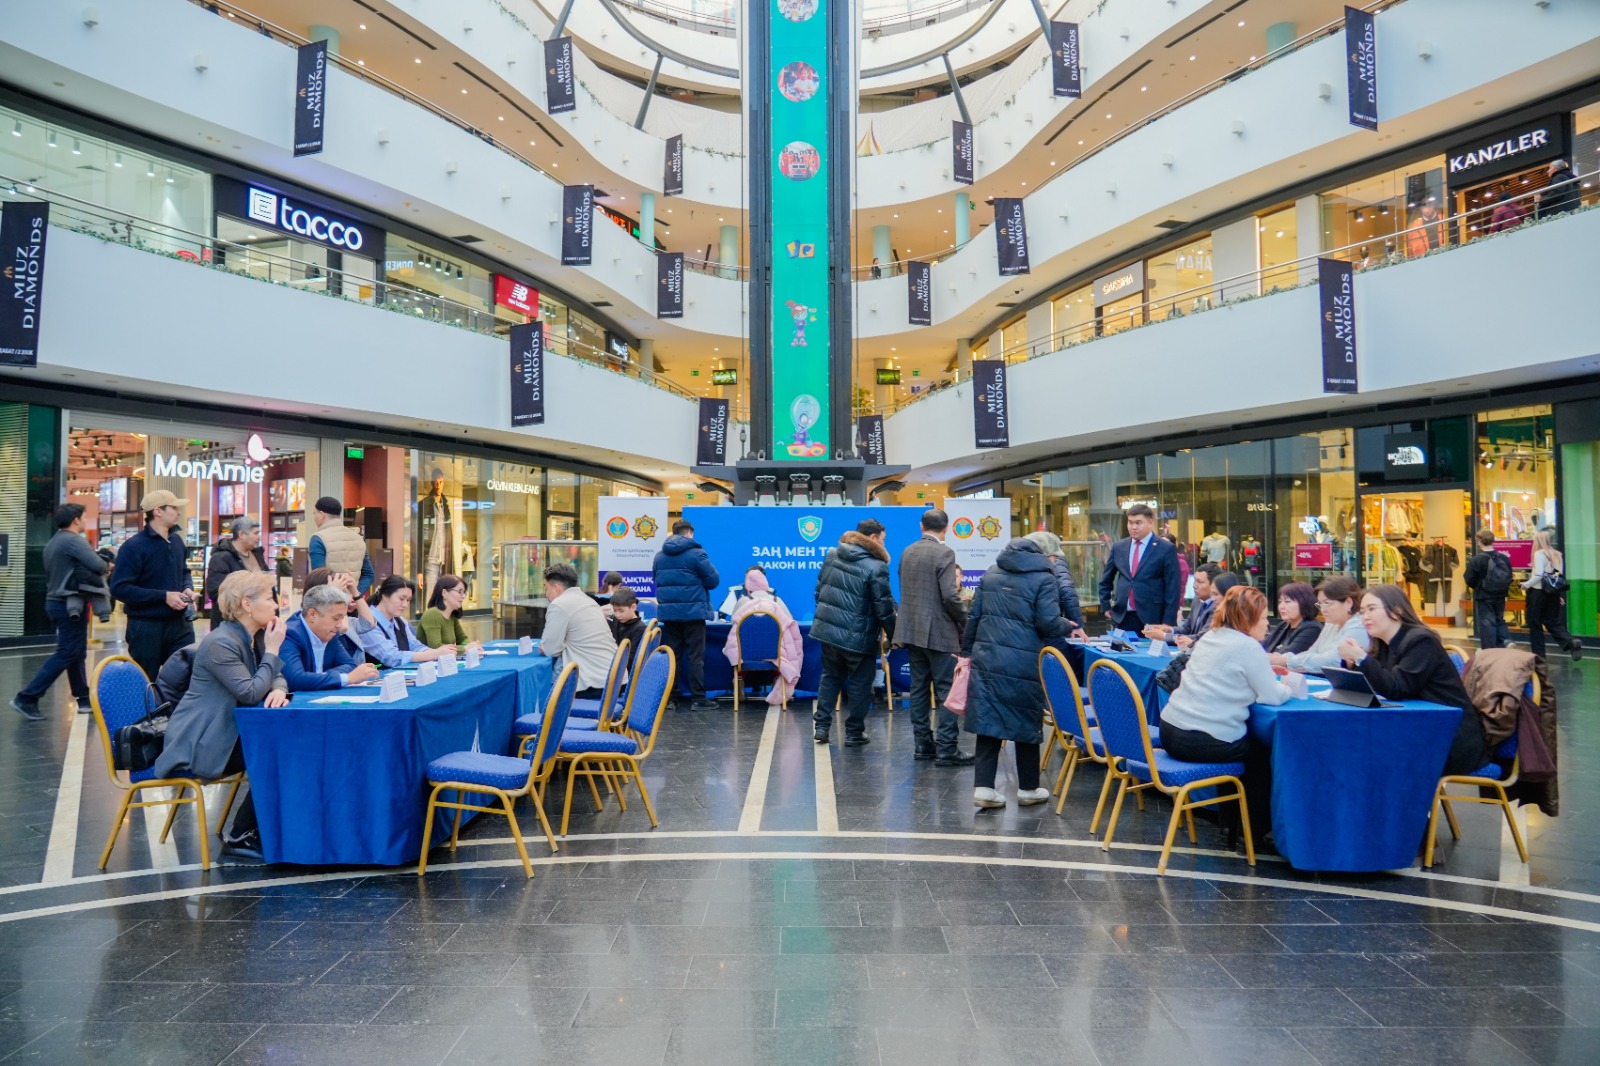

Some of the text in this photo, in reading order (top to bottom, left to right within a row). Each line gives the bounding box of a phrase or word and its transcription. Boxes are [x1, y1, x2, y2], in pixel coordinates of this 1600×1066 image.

[563, 44, 572, 94] DIAMONDS
[1070, 29, 1078, 80] DIAMONDS
[1358, 41, 1366, 81] MIUZ
[1364, 24, 1374, 103] DIAMONDS
[307, 72, 316, 110] MIUZ
[314, 51, 324, 127] DIAMONDS
[1450, 129, 1548, 172] KANZLER
[281, 198, 362, 250] tacco
[582, 192, 590, 247] DIAMONDS
[1007, 218, 1015, 244] MIUZ
[1013, 204, 1025, 257] DIAMONDS
[14, 246, 28, 299] MIUZ
[24, 217, 42, 328] DIAMONDS
[1333, 296, 1344, 339] MIUZ
[1341, 273, 1353, 364] DIAMONDS
[524, 350, 532, 384] MIUZ
[987, 384, 995, 412] MIUZ
[994, 368, 1004, 428] DIAMONDS
[716, 406, 725, 454] DIAMONDS
[874, 420, 882, 464] DIAMONDS
[154, 453, 264, 483] MonAmie
[487, 479, 539, 495] CALVIN KLEIN JEANS
[752, 546, 781, 558] ЗАҢ
[785, 546, 815, 556] МЕН
[758, 561, 794, 569] ЗАКОН
[798, 561, 806, 569] И
